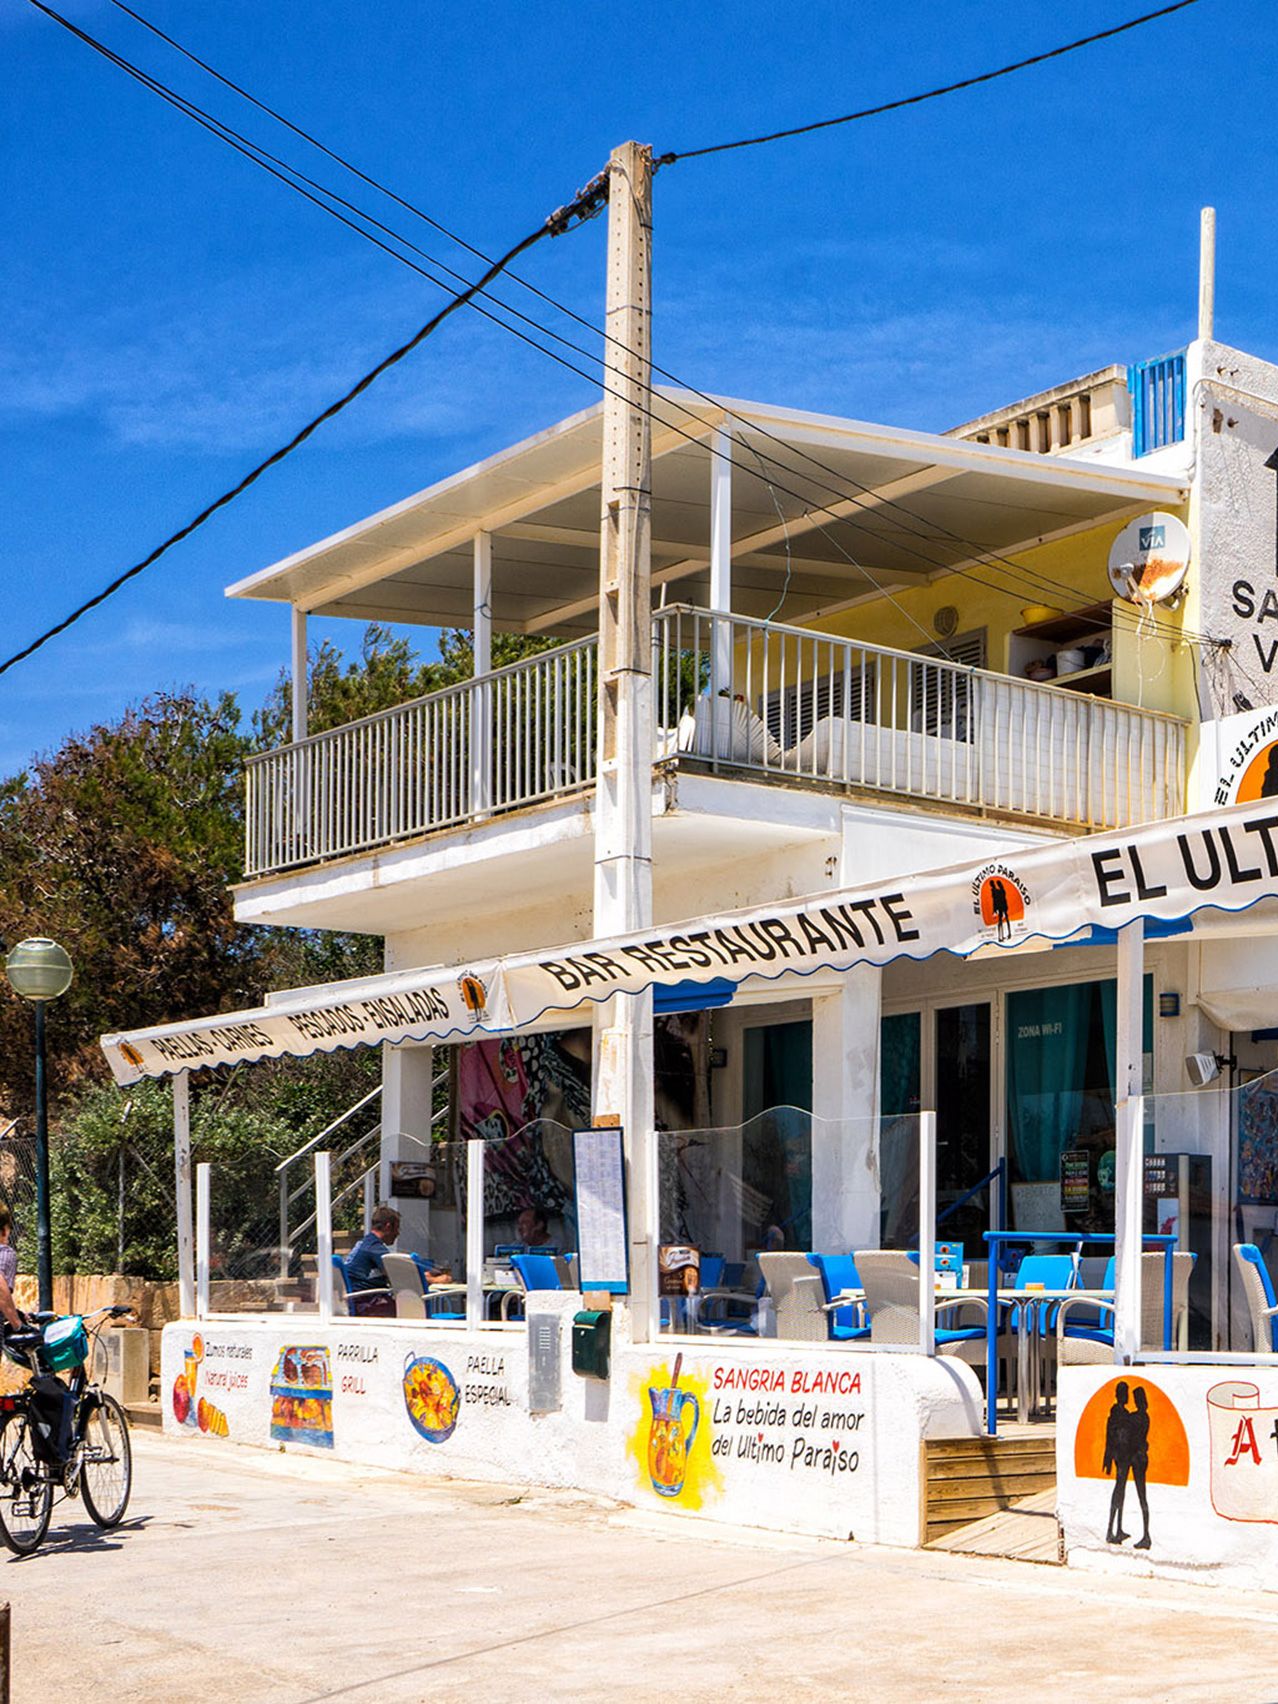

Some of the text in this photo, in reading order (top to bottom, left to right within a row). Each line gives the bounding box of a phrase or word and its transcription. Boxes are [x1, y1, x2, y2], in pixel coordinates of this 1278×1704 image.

[1214, 774, 1235, 805] EL
[972, 864, 1031, 915] EL ULTIMO PARAISO
[1091, 846, 1167, 907] EL
[538, 945, 632, 991] BAR
[634, 893, 920, 971] RESTAURANTE
[150, 1035, 211, 1062] PAELLAS
[218, 1023, 274, 1054] CARNES
[287, 1004, 365, 1041] PESCADOS
[367, 986, 450, 1030] ENSALADAS
[1018, 1021, 1063, 1039] ZONA WI-FI
[206, 1341, 253, 1360] Zumos naturales
[337, 1344, 379, 1363] PARRILLA
[205, 1369, 228, 1386] Natural
[466, 1355, 505, 1376] PAELLA
[713, 1366, 861, 1394] SANGRIA BLANCA
[341, 1375, 367, 1395] GRILL
[465, 1384, 512, 1407] ESPECIAL
[713, 1398, 865, 1431] La bebida del amor
[711, 1432, 859, 1475] del Ultimo Paraiso
[1224, 1416, 1263, 1467] A
